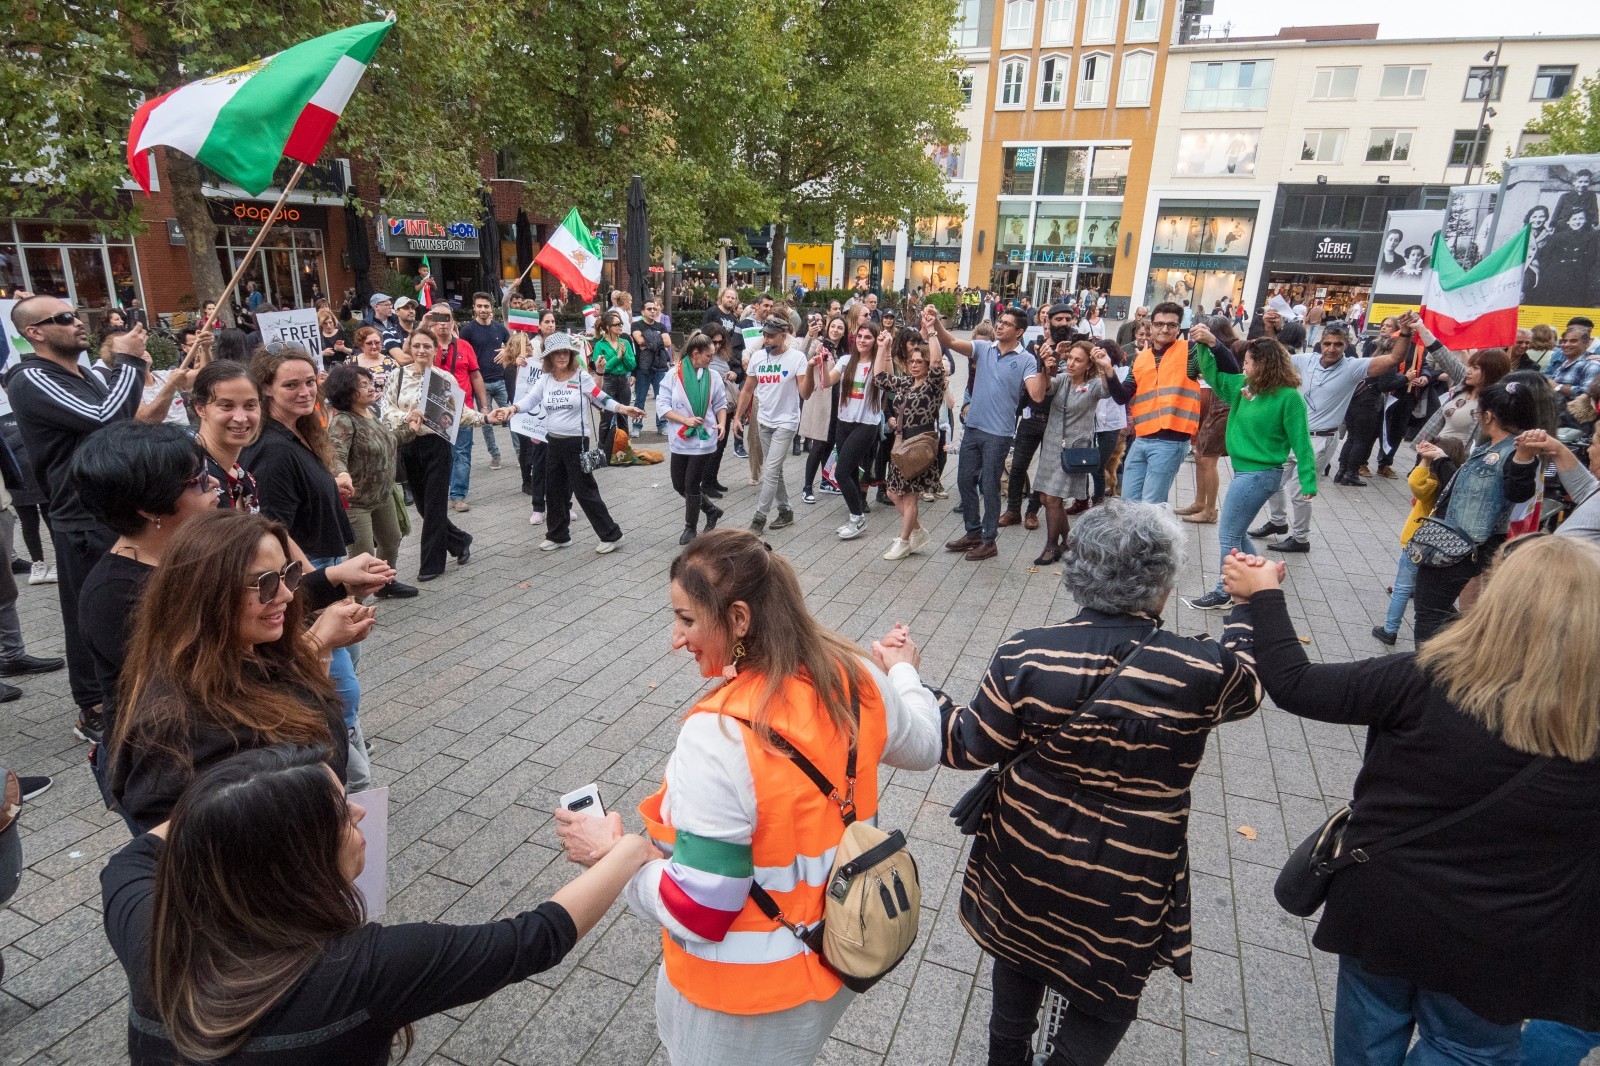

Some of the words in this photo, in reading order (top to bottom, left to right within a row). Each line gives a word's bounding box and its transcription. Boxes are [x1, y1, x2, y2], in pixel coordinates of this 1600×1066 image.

[409, 238, 465, 251] TWINSPORT
[1317, 242, 1352, 254] SIEBEL
[1010, 249, 1093, 264] PRIMARK
[1172, 259, 1220, 268] PRIMARK
[280, 324, 318, 341] FREE
[758, 364, 781, 373] IRAN
